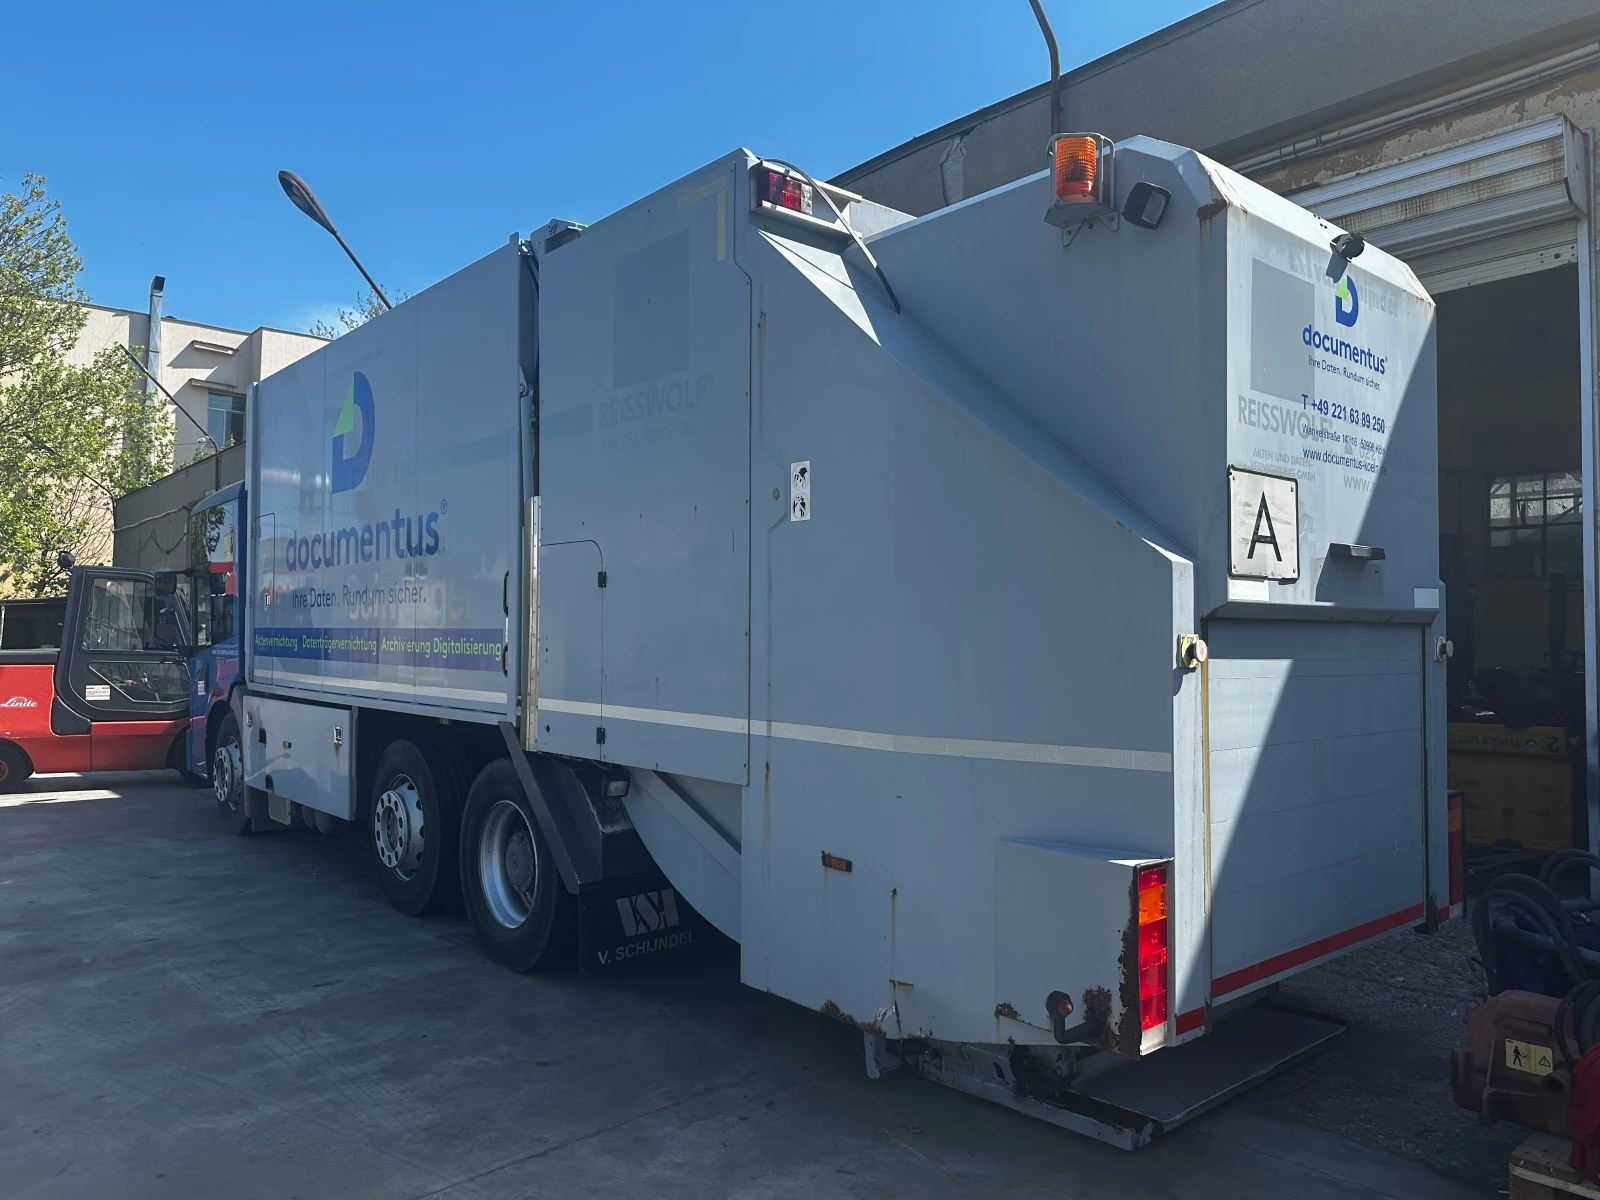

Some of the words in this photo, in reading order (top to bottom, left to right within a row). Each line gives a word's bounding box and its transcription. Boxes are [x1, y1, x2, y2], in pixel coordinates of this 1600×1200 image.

[1308, 355, 1321, 368] Ihre
[1321, 360, 1342, 375] Daten.
[1343, 367, 1365, 383] Rundum
[1365, 377, 1381, 390] sicher.
[1238, 395, 1332, 443] REISSWOLF
[1301, 394, 1309, 410] T
[1311, 399, 1329, 416] +49
[1331, 402, 1347, 421] 221
[1349, 408, 1360, 425] 63
[1361, 411, 1371, 429] 89
[1372, 416, 1385, 433] 250
[1275, 452, 1290, 464] UND
[1247, 490, 1283, 562] A
[292, 588, 308, 609] Ihre
[310, 587, 340, 608] Daten.
[342, 583, 386, 606] Rundum
[388, 580, 427, 605] sicher.
[381, 635, 431, 658] Archivierung
[433, 637, 502, 661] Digitalisierung
[0, 696, 37, 707] Linde
